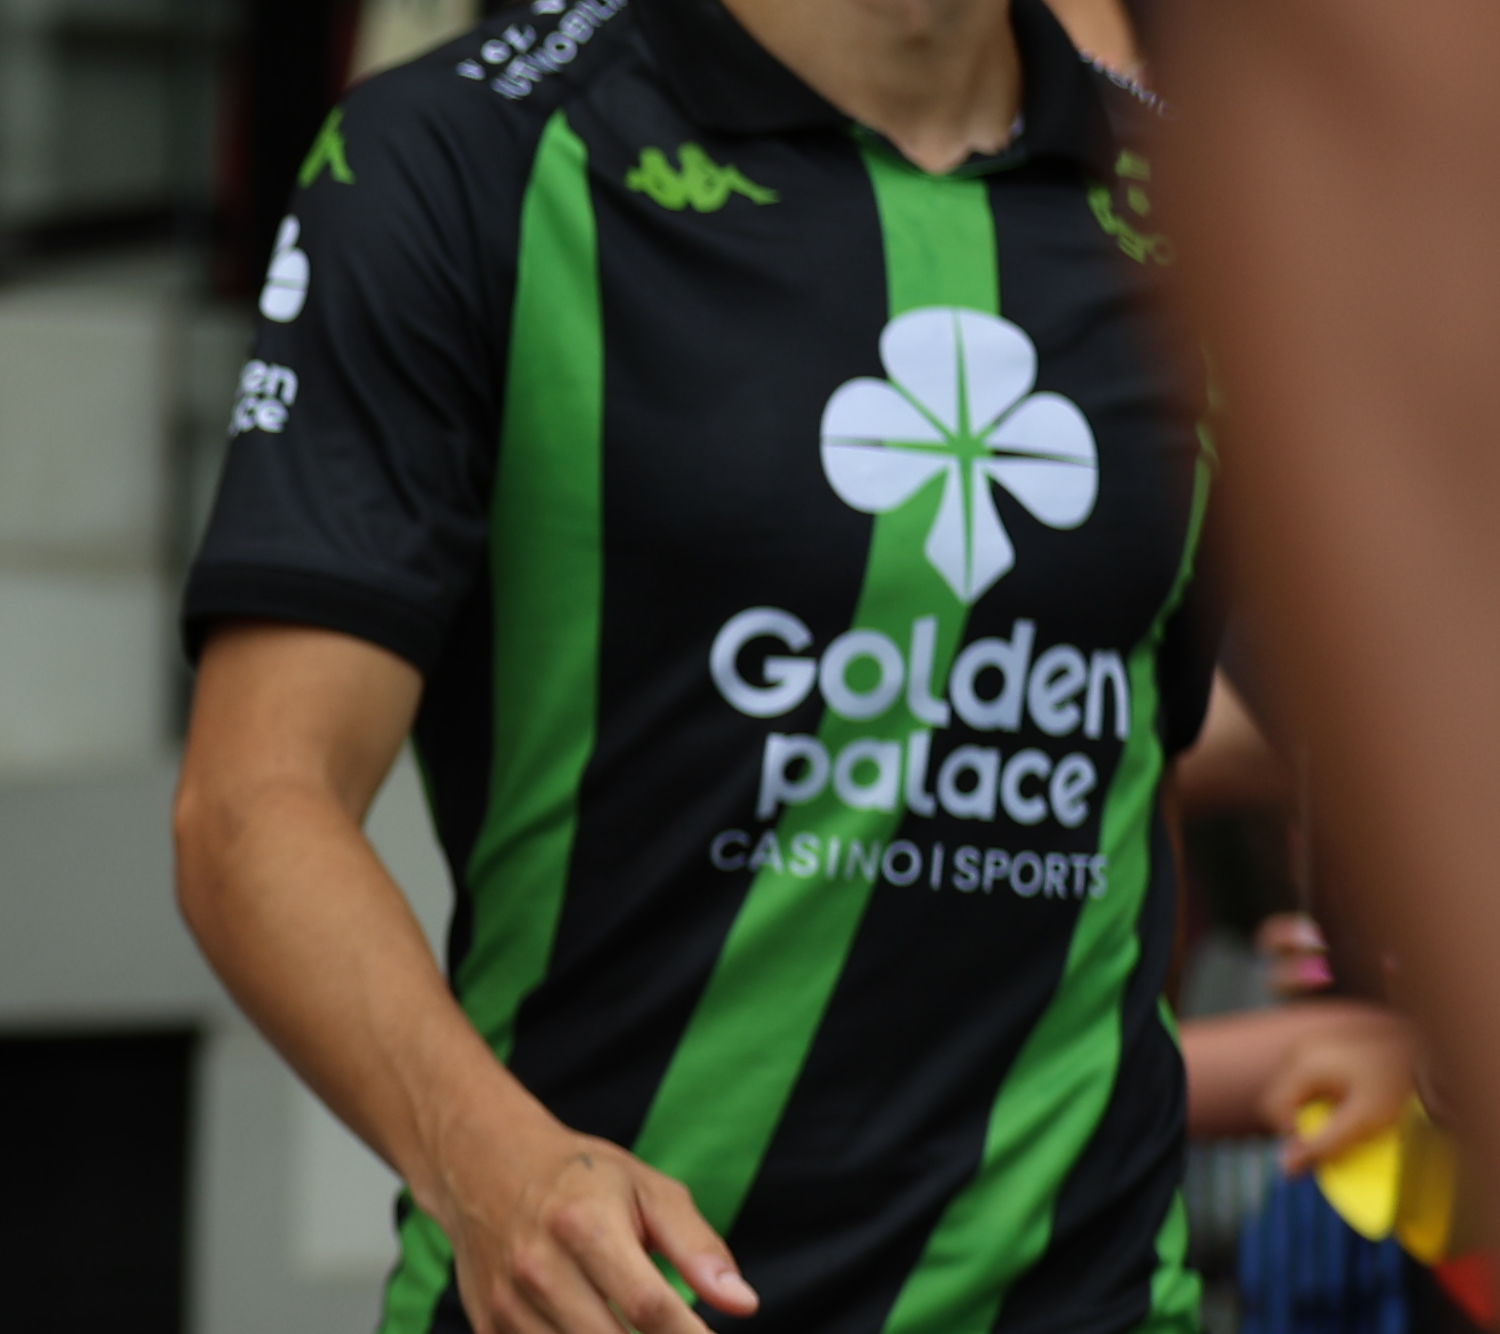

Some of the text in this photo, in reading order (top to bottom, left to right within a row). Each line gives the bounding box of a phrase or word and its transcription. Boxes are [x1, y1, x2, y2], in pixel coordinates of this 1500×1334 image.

[708, 605, 1131, 742] Golden
[755, 729, 1098, 827] palace
[710, 828, 1109, 899] CASINO SPORTS
